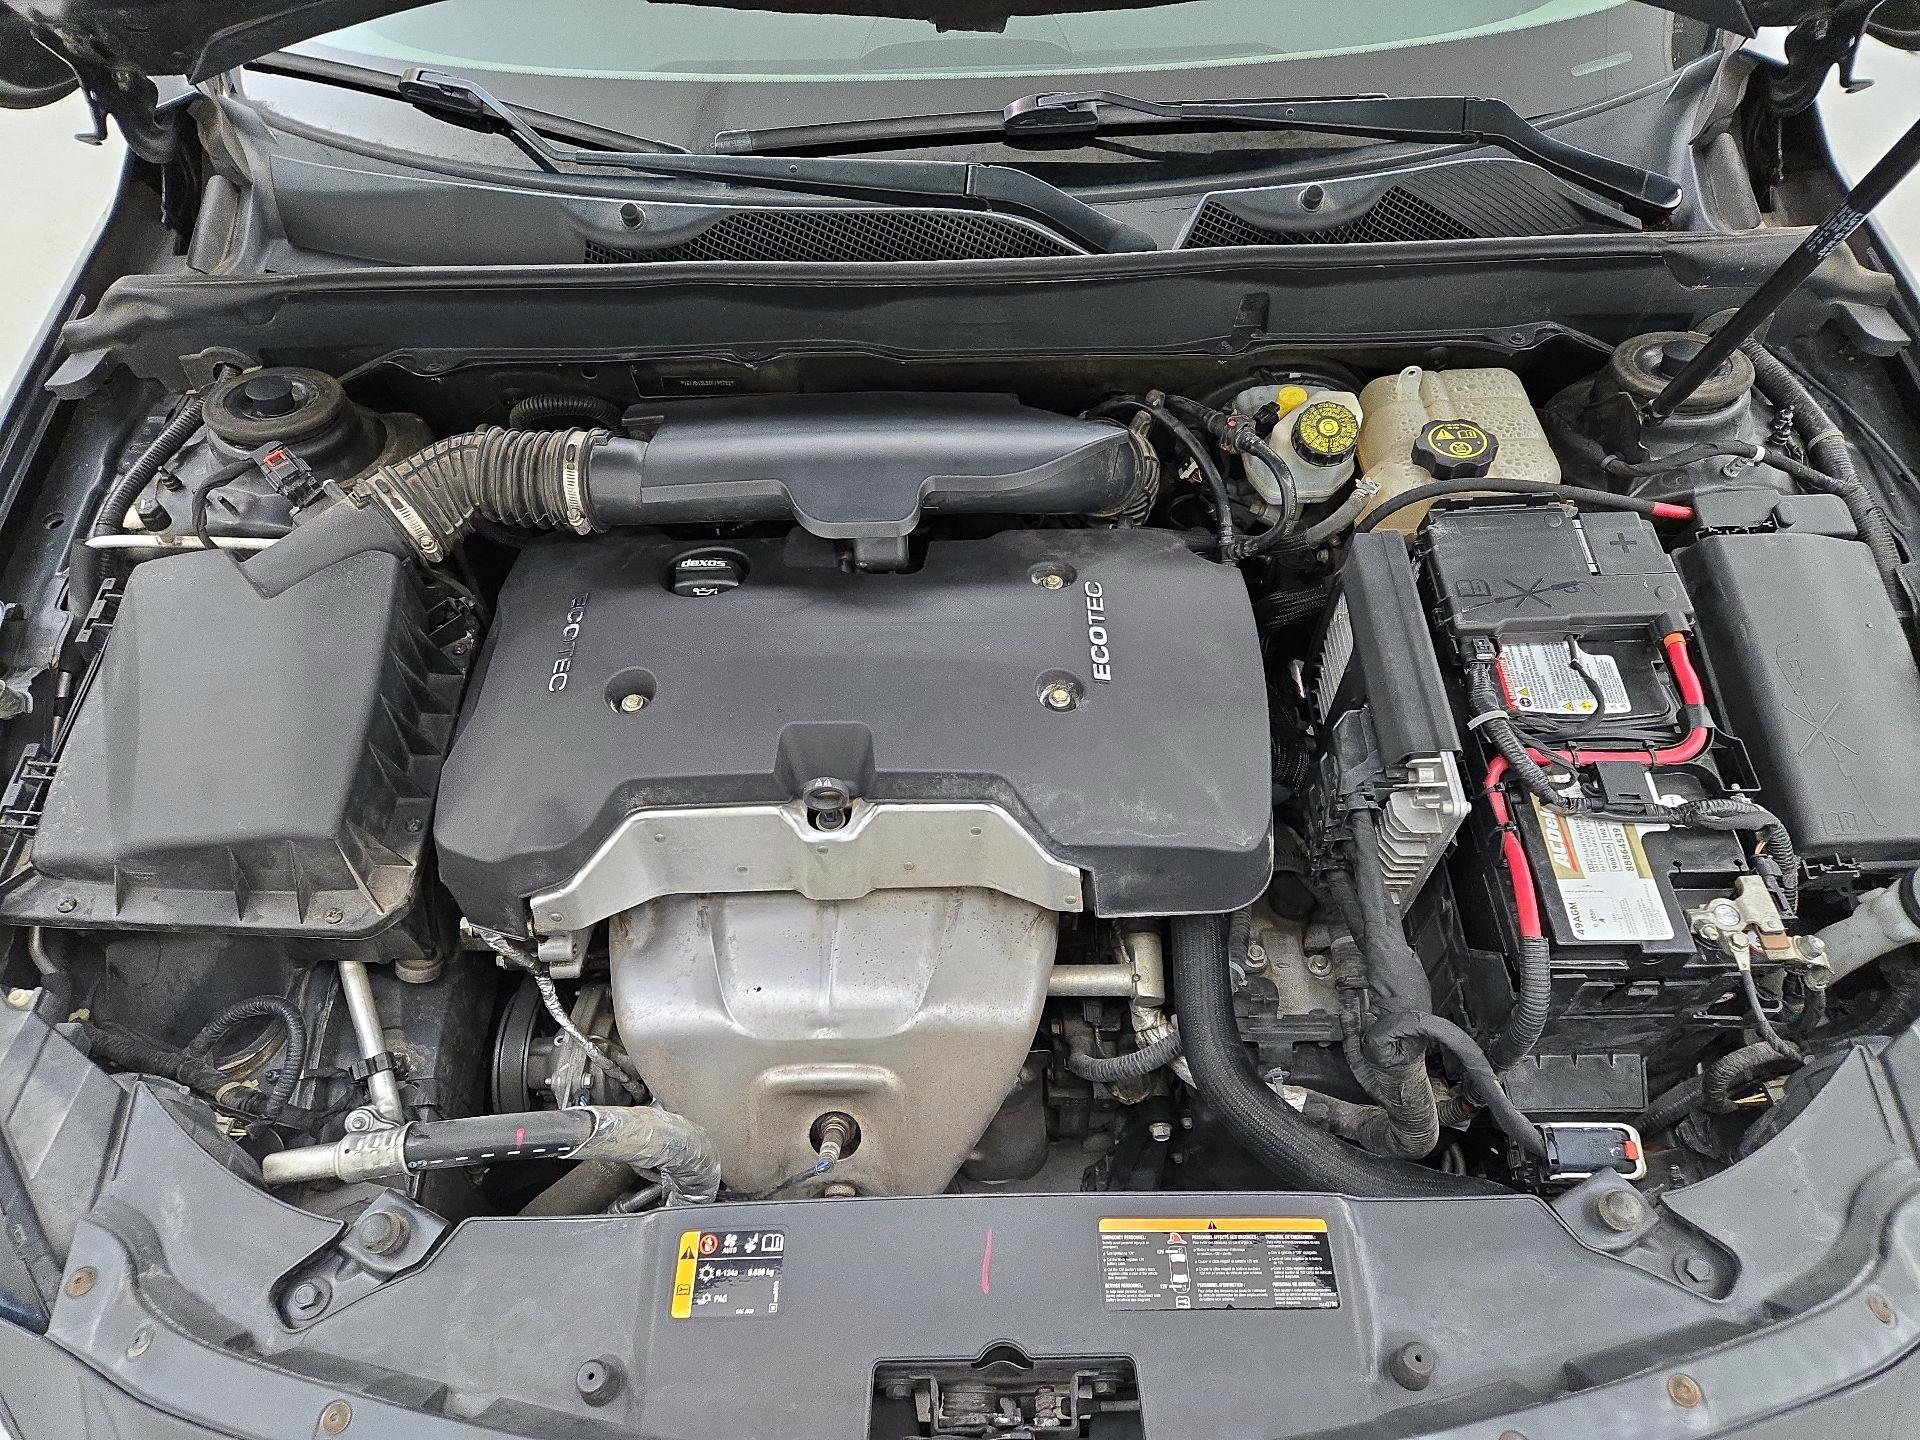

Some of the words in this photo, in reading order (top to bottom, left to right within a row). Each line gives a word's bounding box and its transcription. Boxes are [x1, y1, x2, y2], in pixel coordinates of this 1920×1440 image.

[681, 559, 727, 568] dexos
[1084, 581, 1112, 681] ECOTEC
[1538, 808, 1572, 869] ACDel
[1568, 902, 1585, 935] 49AGM
[715, 1269, 739, 1277] R-134a
[766, 1268, 775, 1278] kg
[714, 1294, 728, 1303] PAG
